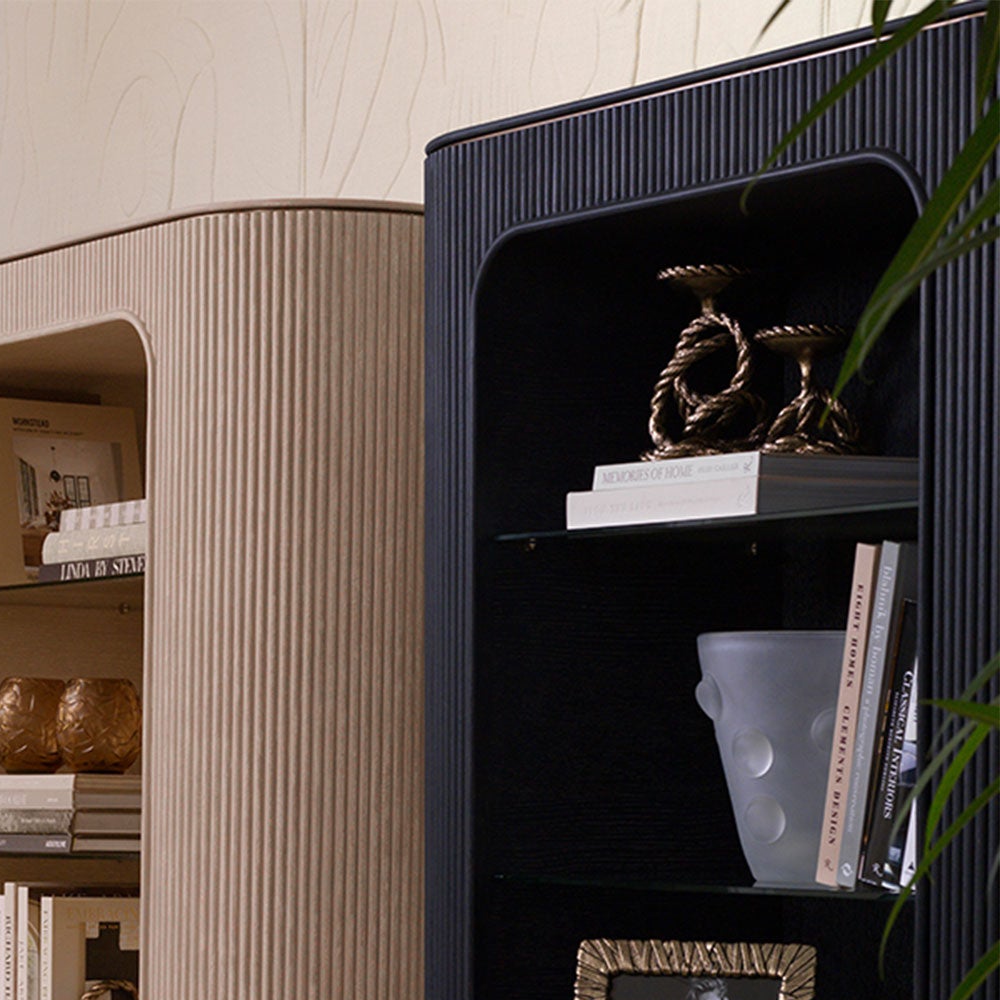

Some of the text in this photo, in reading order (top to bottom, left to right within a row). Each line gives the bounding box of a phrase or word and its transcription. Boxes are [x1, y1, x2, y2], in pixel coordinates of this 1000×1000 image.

[602, 469, 649, 484] MEMORIES
[650, 467, 663, 481] OF
[665, 464, 693, 479] HOME
[60, 562, 91, 581] LINDA
[94, 560, 108, 578] BY
[846, 584, 864, 687] EIGHT HOMES
[874, 624, 886, 640] by
[866, 646, 882, 695] boman
[883, 670, 914, 820] CLASSICAL INTERIORS
[828, 705, 850, 845] CLEMENTS DESIGN
